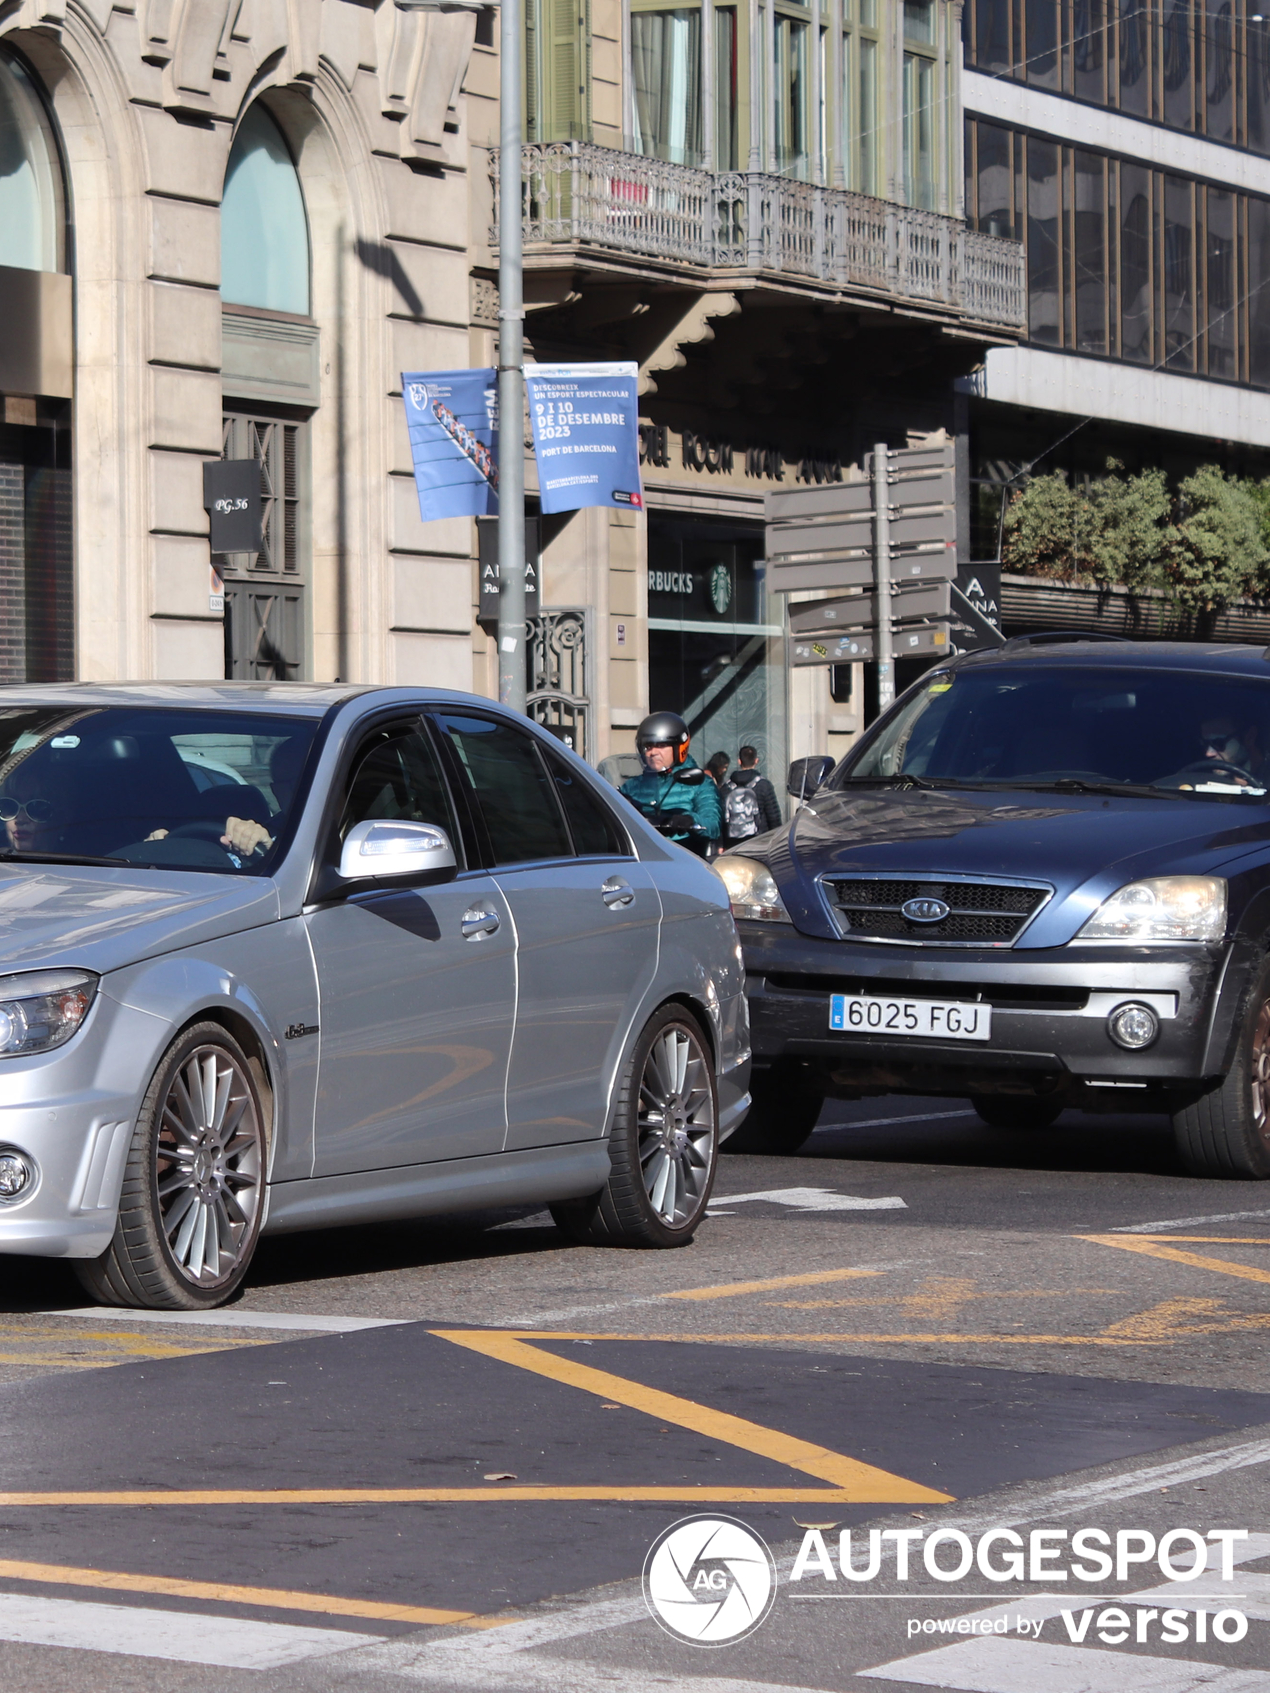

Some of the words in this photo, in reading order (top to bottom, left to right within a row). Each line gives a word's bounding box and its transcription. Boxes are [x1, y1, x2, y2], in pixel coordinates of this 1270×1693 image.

[533, 384, 579, 392] DESCOBREIX
[547, 391, 574, 399] ESPORT
[576, 390, 630, 398] ESPECTACULAR
[535, 403, 545, 415] 9
[548, 402, 555, 414] I
[558, 402, 574, 414] 10
[538, 415, 555, 428] DE
[558, 413, 626, 426] DESEMBRE
[539, 426, 571, 441] 2023
[542, 446, 561, 457] PORT
[562, 445, 573, 454] DE
[574, 445, 617, 453] BARCELONA
[215, 499, 249, 515] PG.56
[909, 902, 942, 916] KIA
[834, 1015, 841, 1024] E
[848, 1001, 919, 1030] 6025
[930, 1006, 979, 1034] FGJ
